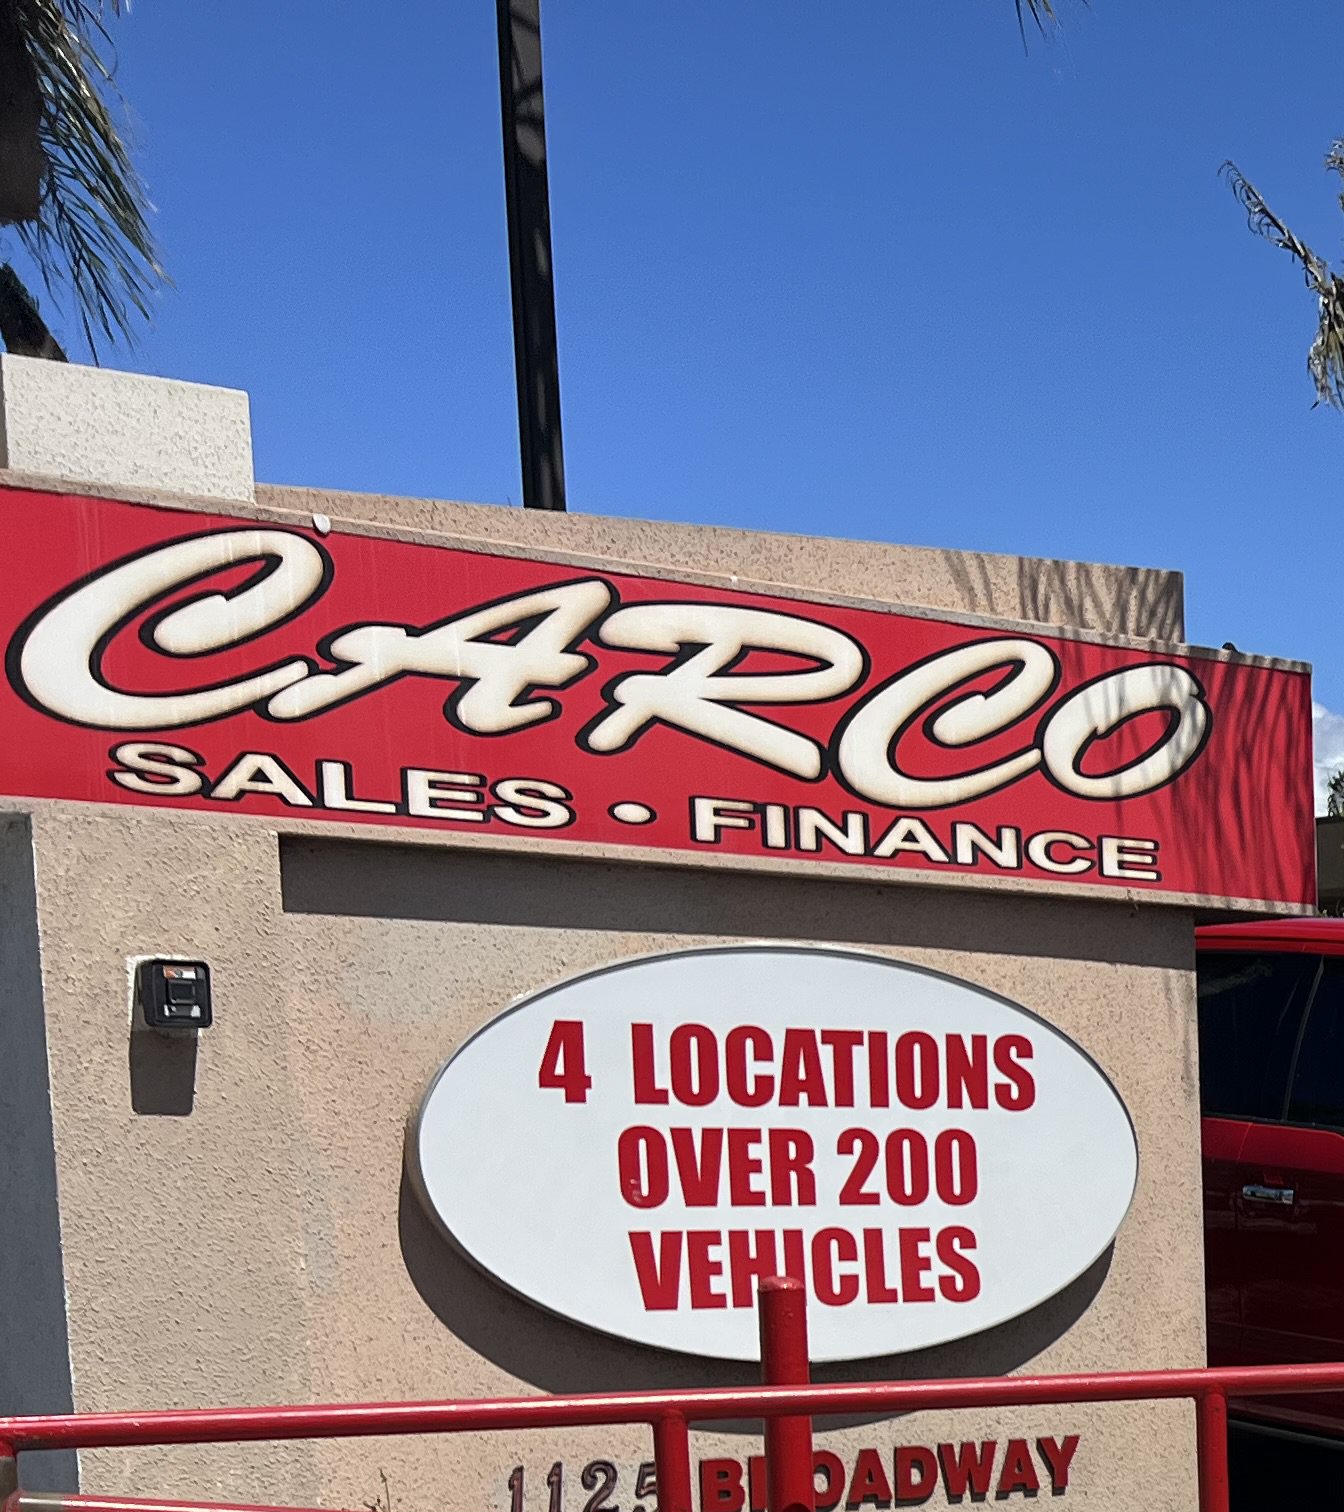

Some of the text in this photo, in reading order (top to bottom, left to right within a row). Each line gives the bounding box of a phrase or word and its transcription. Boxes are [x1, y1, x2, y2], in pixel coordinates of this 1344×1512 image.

[8, 525, 1210, 806] CARCO
[110, 742, 1163, 882] SALES FINANCE
[538, 1020, 1036, 1112] 4 LOCATIONS
[617, 1125, 978, 1209] OVER 200
[629, 1226, 982, 1311] VEHICLES
